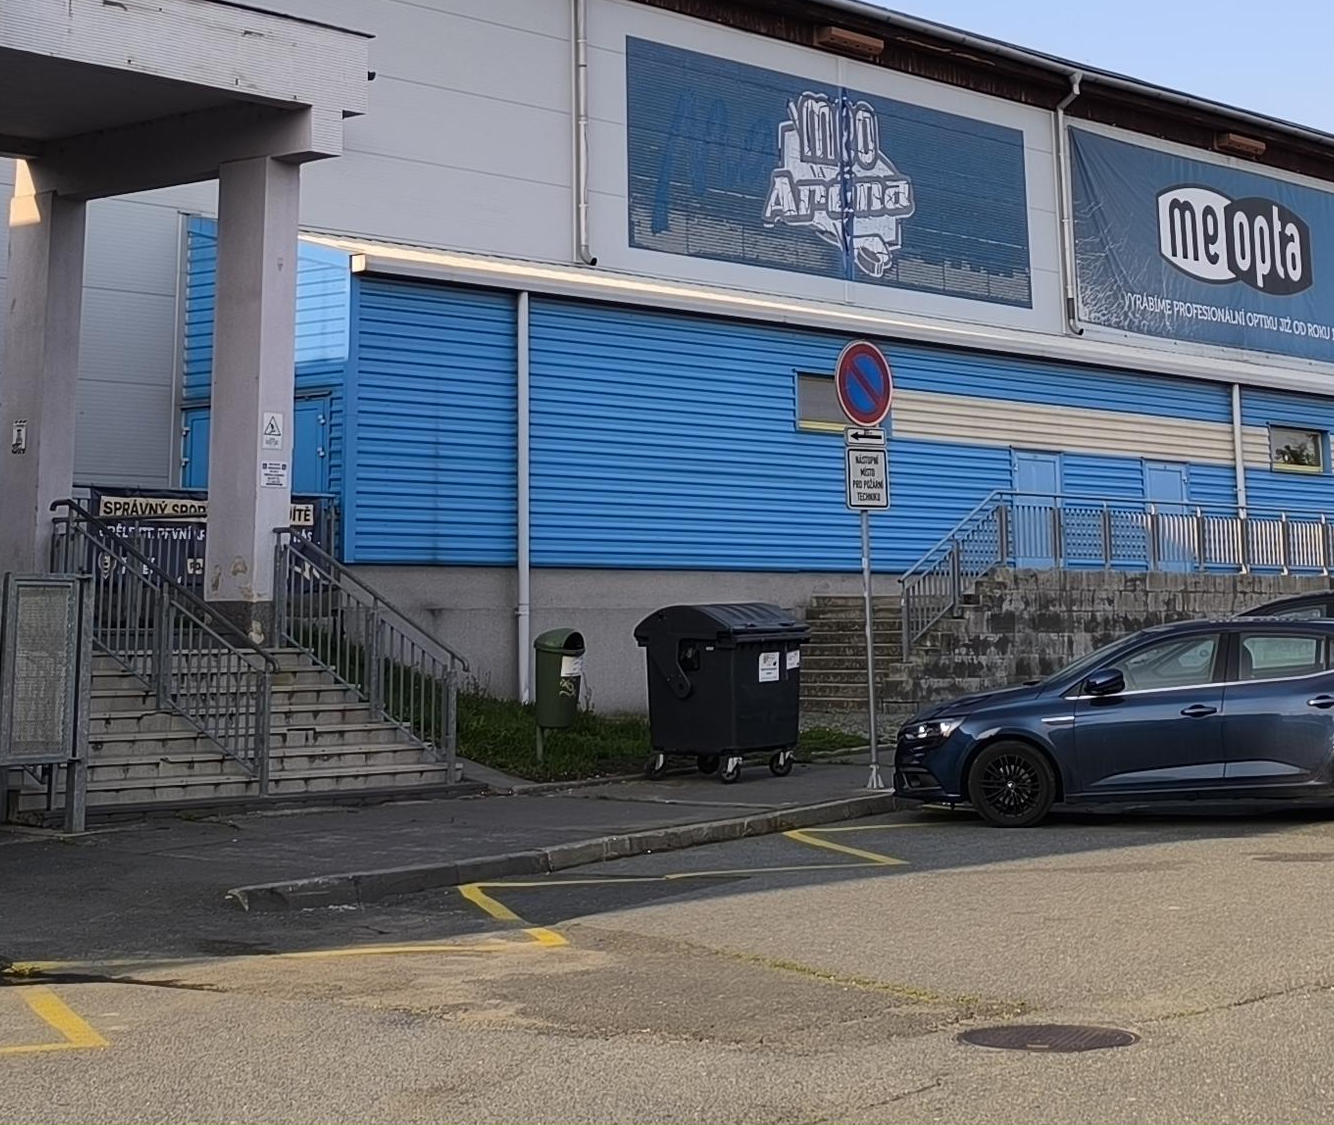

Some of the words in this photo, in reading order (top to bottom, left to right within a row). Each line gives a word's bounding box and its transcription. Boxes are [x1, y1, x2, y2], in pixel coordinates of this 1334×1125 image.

[1167, 197, 1303, 288] meopta
[1124, 292, 1172, 314] VYRÁBÍME
[1173, 301, 1245, 326] PROFESIONÁLNÍ
[1246, 312, 1278, 330] OPTIKU
[1293, 325, 1307, 336] OD
[1307, 323, 1330, 340] ROKU
[103, 499, 169, 516] SPRÁVNÝ
